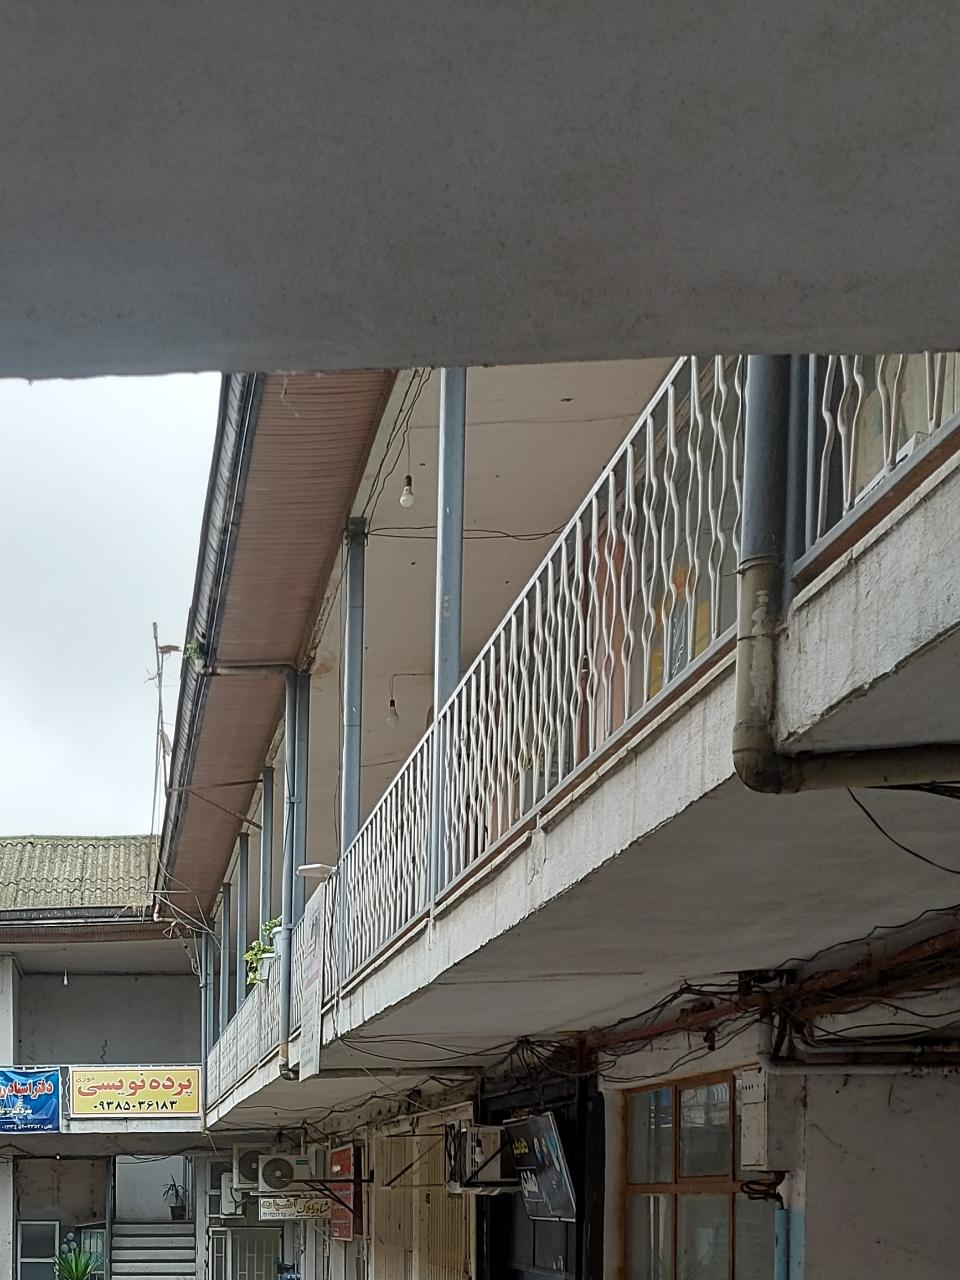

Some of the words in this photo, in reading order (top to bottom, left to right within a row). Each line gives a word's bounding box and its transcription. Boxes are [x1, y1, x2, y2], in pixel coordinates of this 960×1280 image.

[8, 1080, 32, 1096] اسناد
[31, 1079, 54, 1100] دفتر
[77, 1072, 146, 1097] نویسی
[148, 1076, 194, 1097] پرده
[93, 1099, 178, 1111] ۰۹۳۸۵۰۳۶۱۸۳
